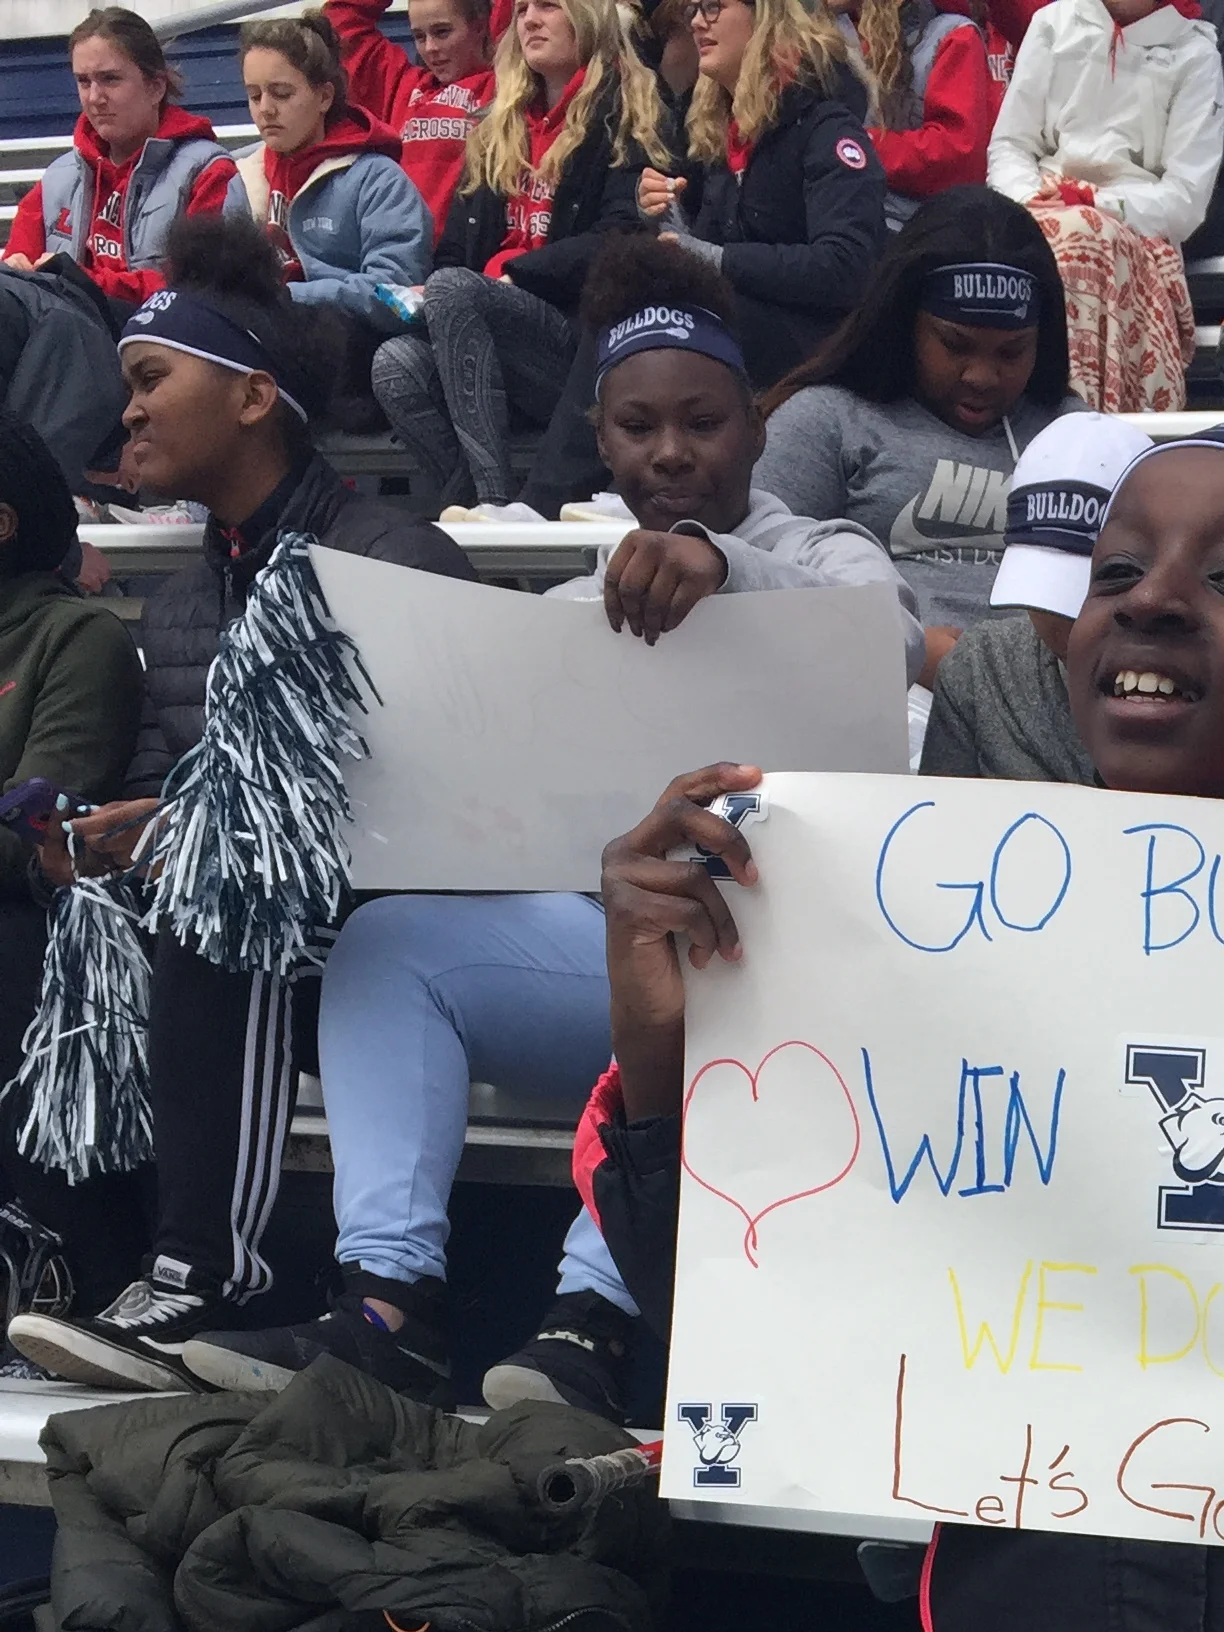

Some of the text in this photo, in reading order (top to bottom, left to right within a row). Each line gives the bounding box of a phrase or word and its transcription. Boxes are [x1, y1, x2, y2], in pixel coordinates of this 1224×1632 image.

[608, 306, 695, 348] BULLDOGS
[954, 273, 1032, 301] BULLDOGS
[917, 458, 1013, 532] NIK
[876, 801, 1072, 953] GO
[861, 1047, 1067, 1204] WIN
[947, 1259, 1098, 1375] WE
[892, 1353, 1090, 1529] Let's
